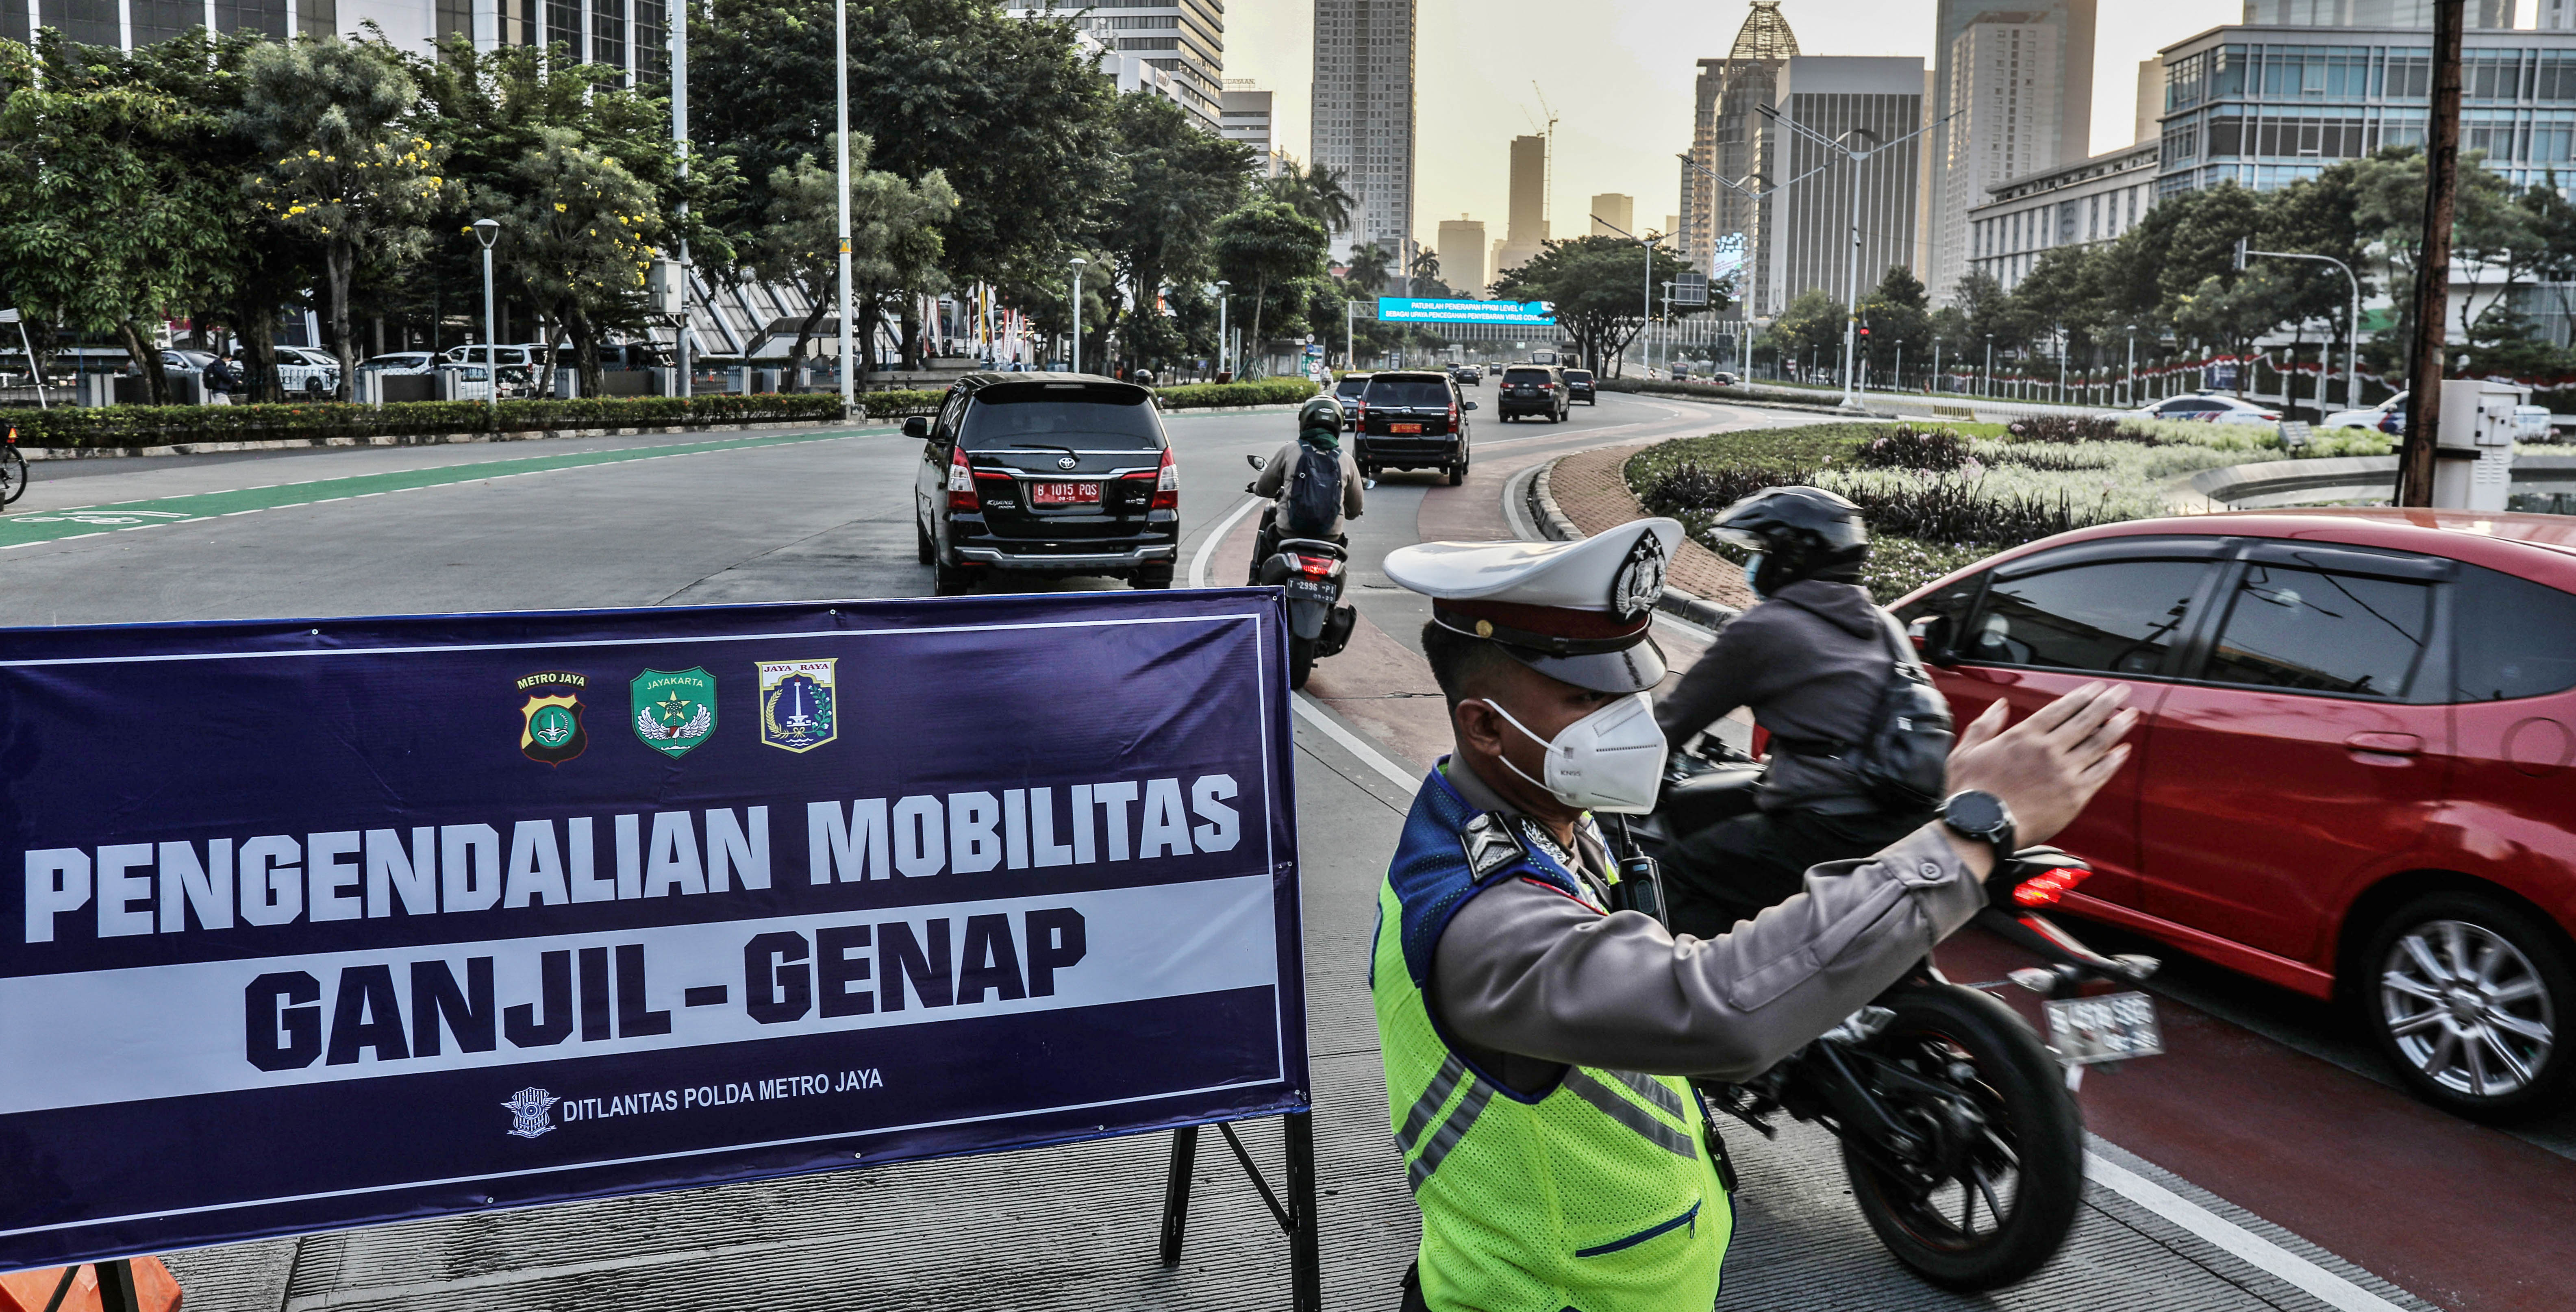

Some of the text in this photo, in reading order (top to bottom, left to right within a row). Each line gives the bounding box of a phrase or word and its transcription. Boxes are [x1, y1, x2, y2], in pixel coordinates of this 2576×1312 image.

[1038, 484, 1097, 496] B 1015 PQS
[1299, 581, 1318, 591] 2996
[517, 673, 585, 690] METRO JAYA
[647, 677, 703, 690] JAYAKARTA
[25, 774, 1240, 944] PENGENDALIAN MOBILITAS
[563, 1067, 883, 1122] DITLANTAS POLDA METRO JAYA
